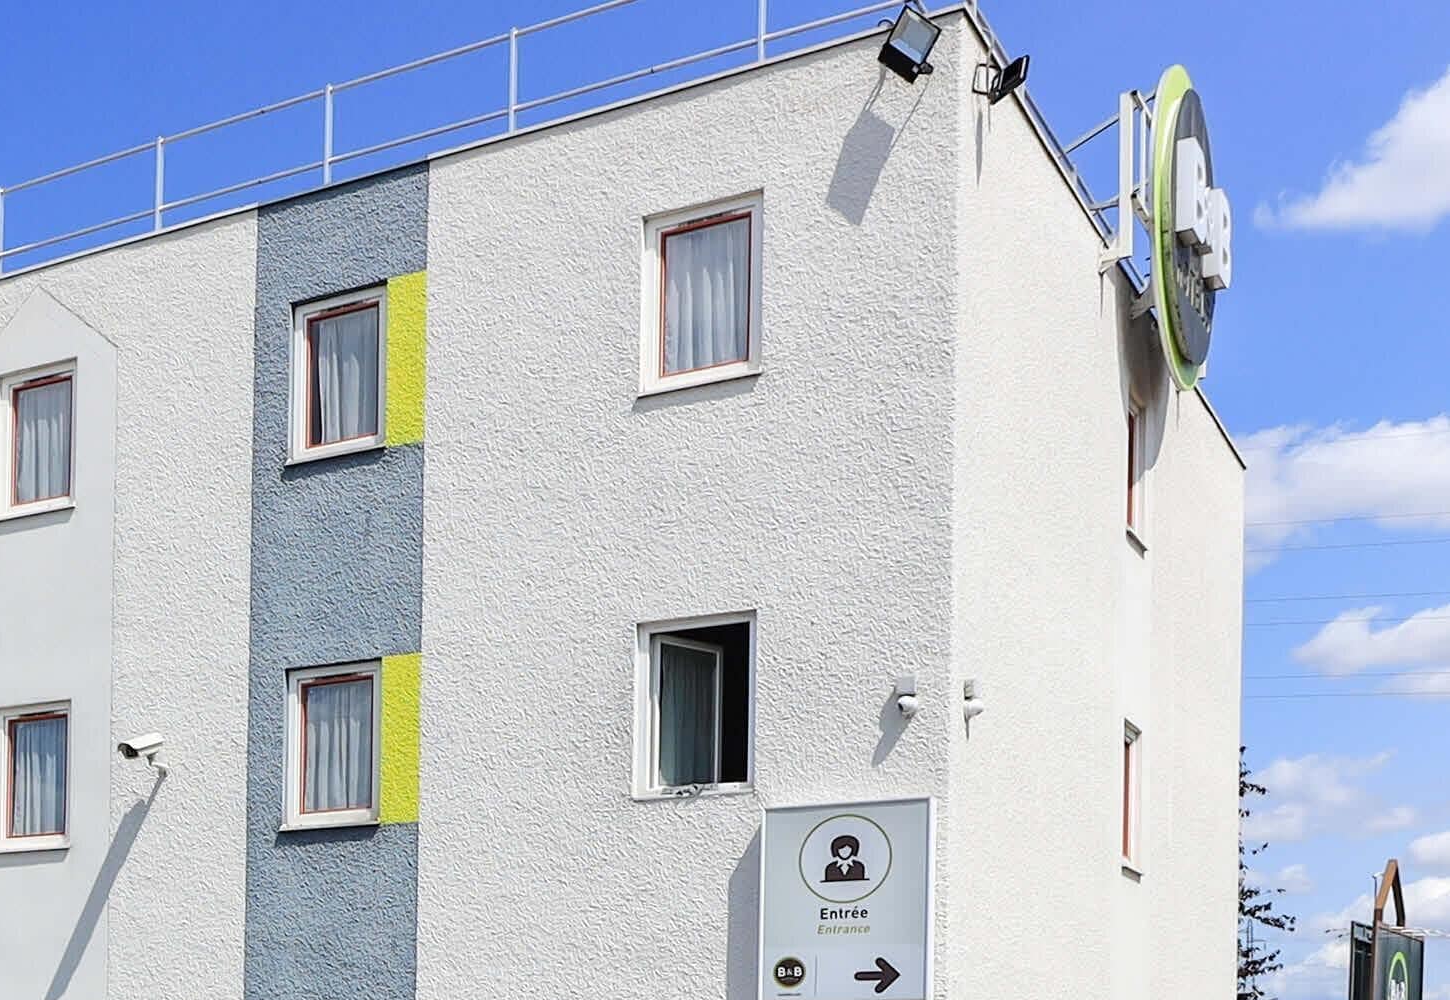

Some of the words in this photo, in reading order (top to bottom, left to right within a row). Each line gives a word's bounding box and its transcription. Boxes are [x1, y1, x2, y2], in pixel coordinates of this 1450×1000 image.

[820, 905, 868, 920] Entrée
[817, 925, 871, 935] Entrance
[777, 966, 803, 978] B&B
